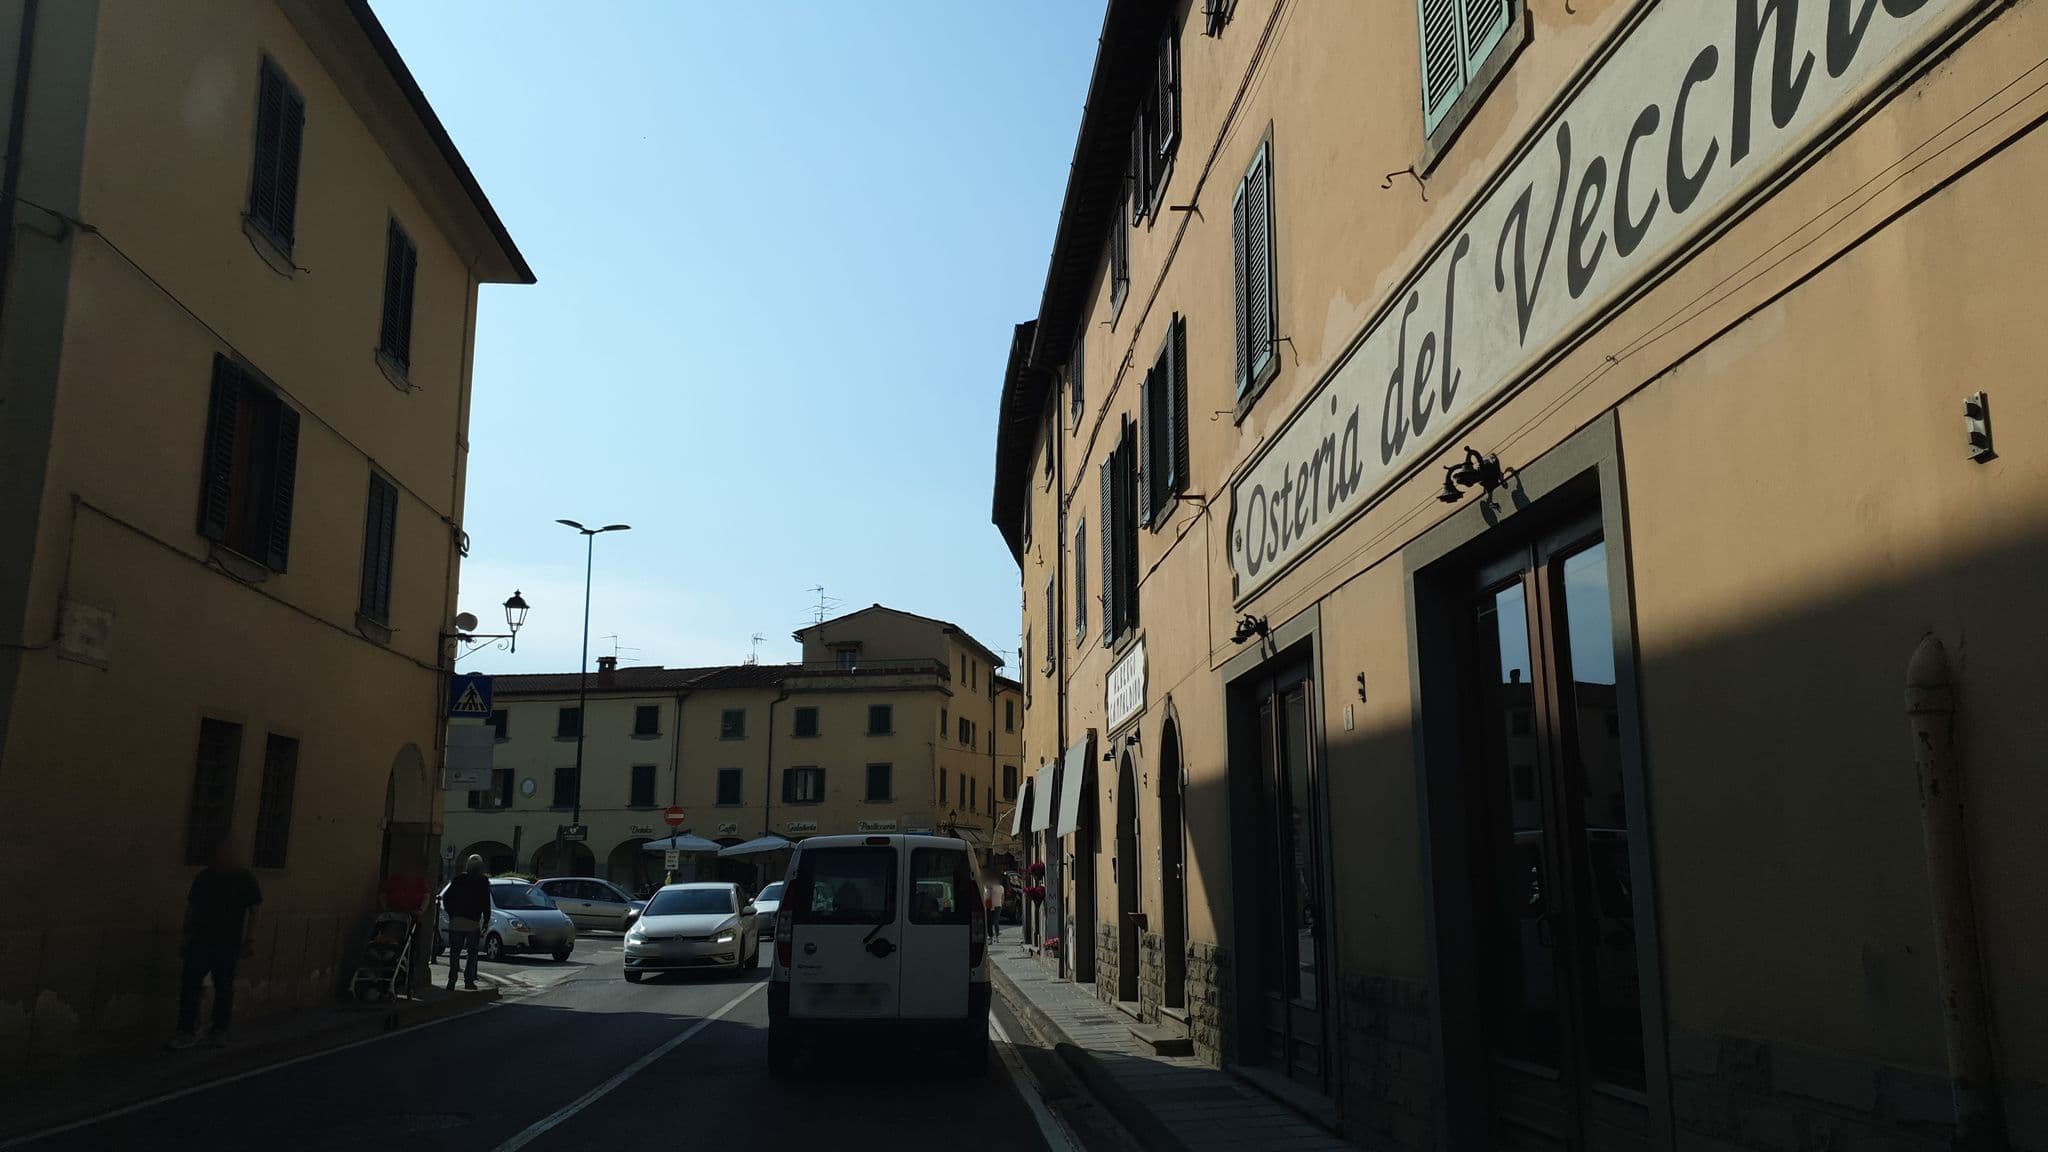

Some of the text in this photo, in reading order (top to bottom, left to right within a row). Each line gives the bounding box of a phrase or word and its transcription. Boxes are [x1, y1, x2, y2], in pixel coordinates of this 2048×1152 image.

[1246, 0, 1936, 576] Osteria del Vecch
